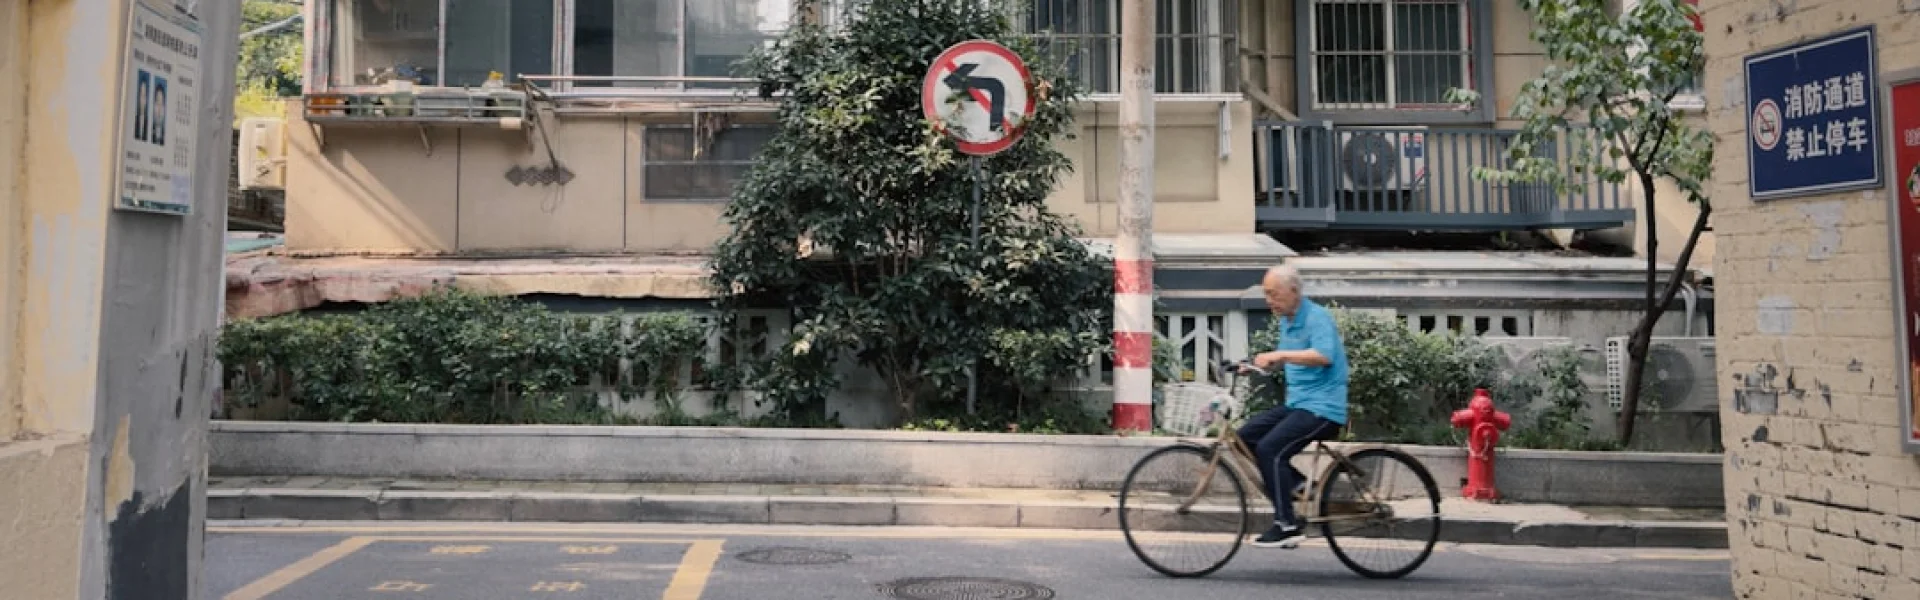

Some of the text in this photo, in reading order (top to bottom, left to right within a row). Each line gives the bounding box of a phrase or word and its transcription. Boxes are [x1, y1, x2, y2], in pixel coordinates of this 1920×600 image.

[1784, 71, 1866, 119] 消防通道
[1785, 116, 1868, 161] 禁止停车
